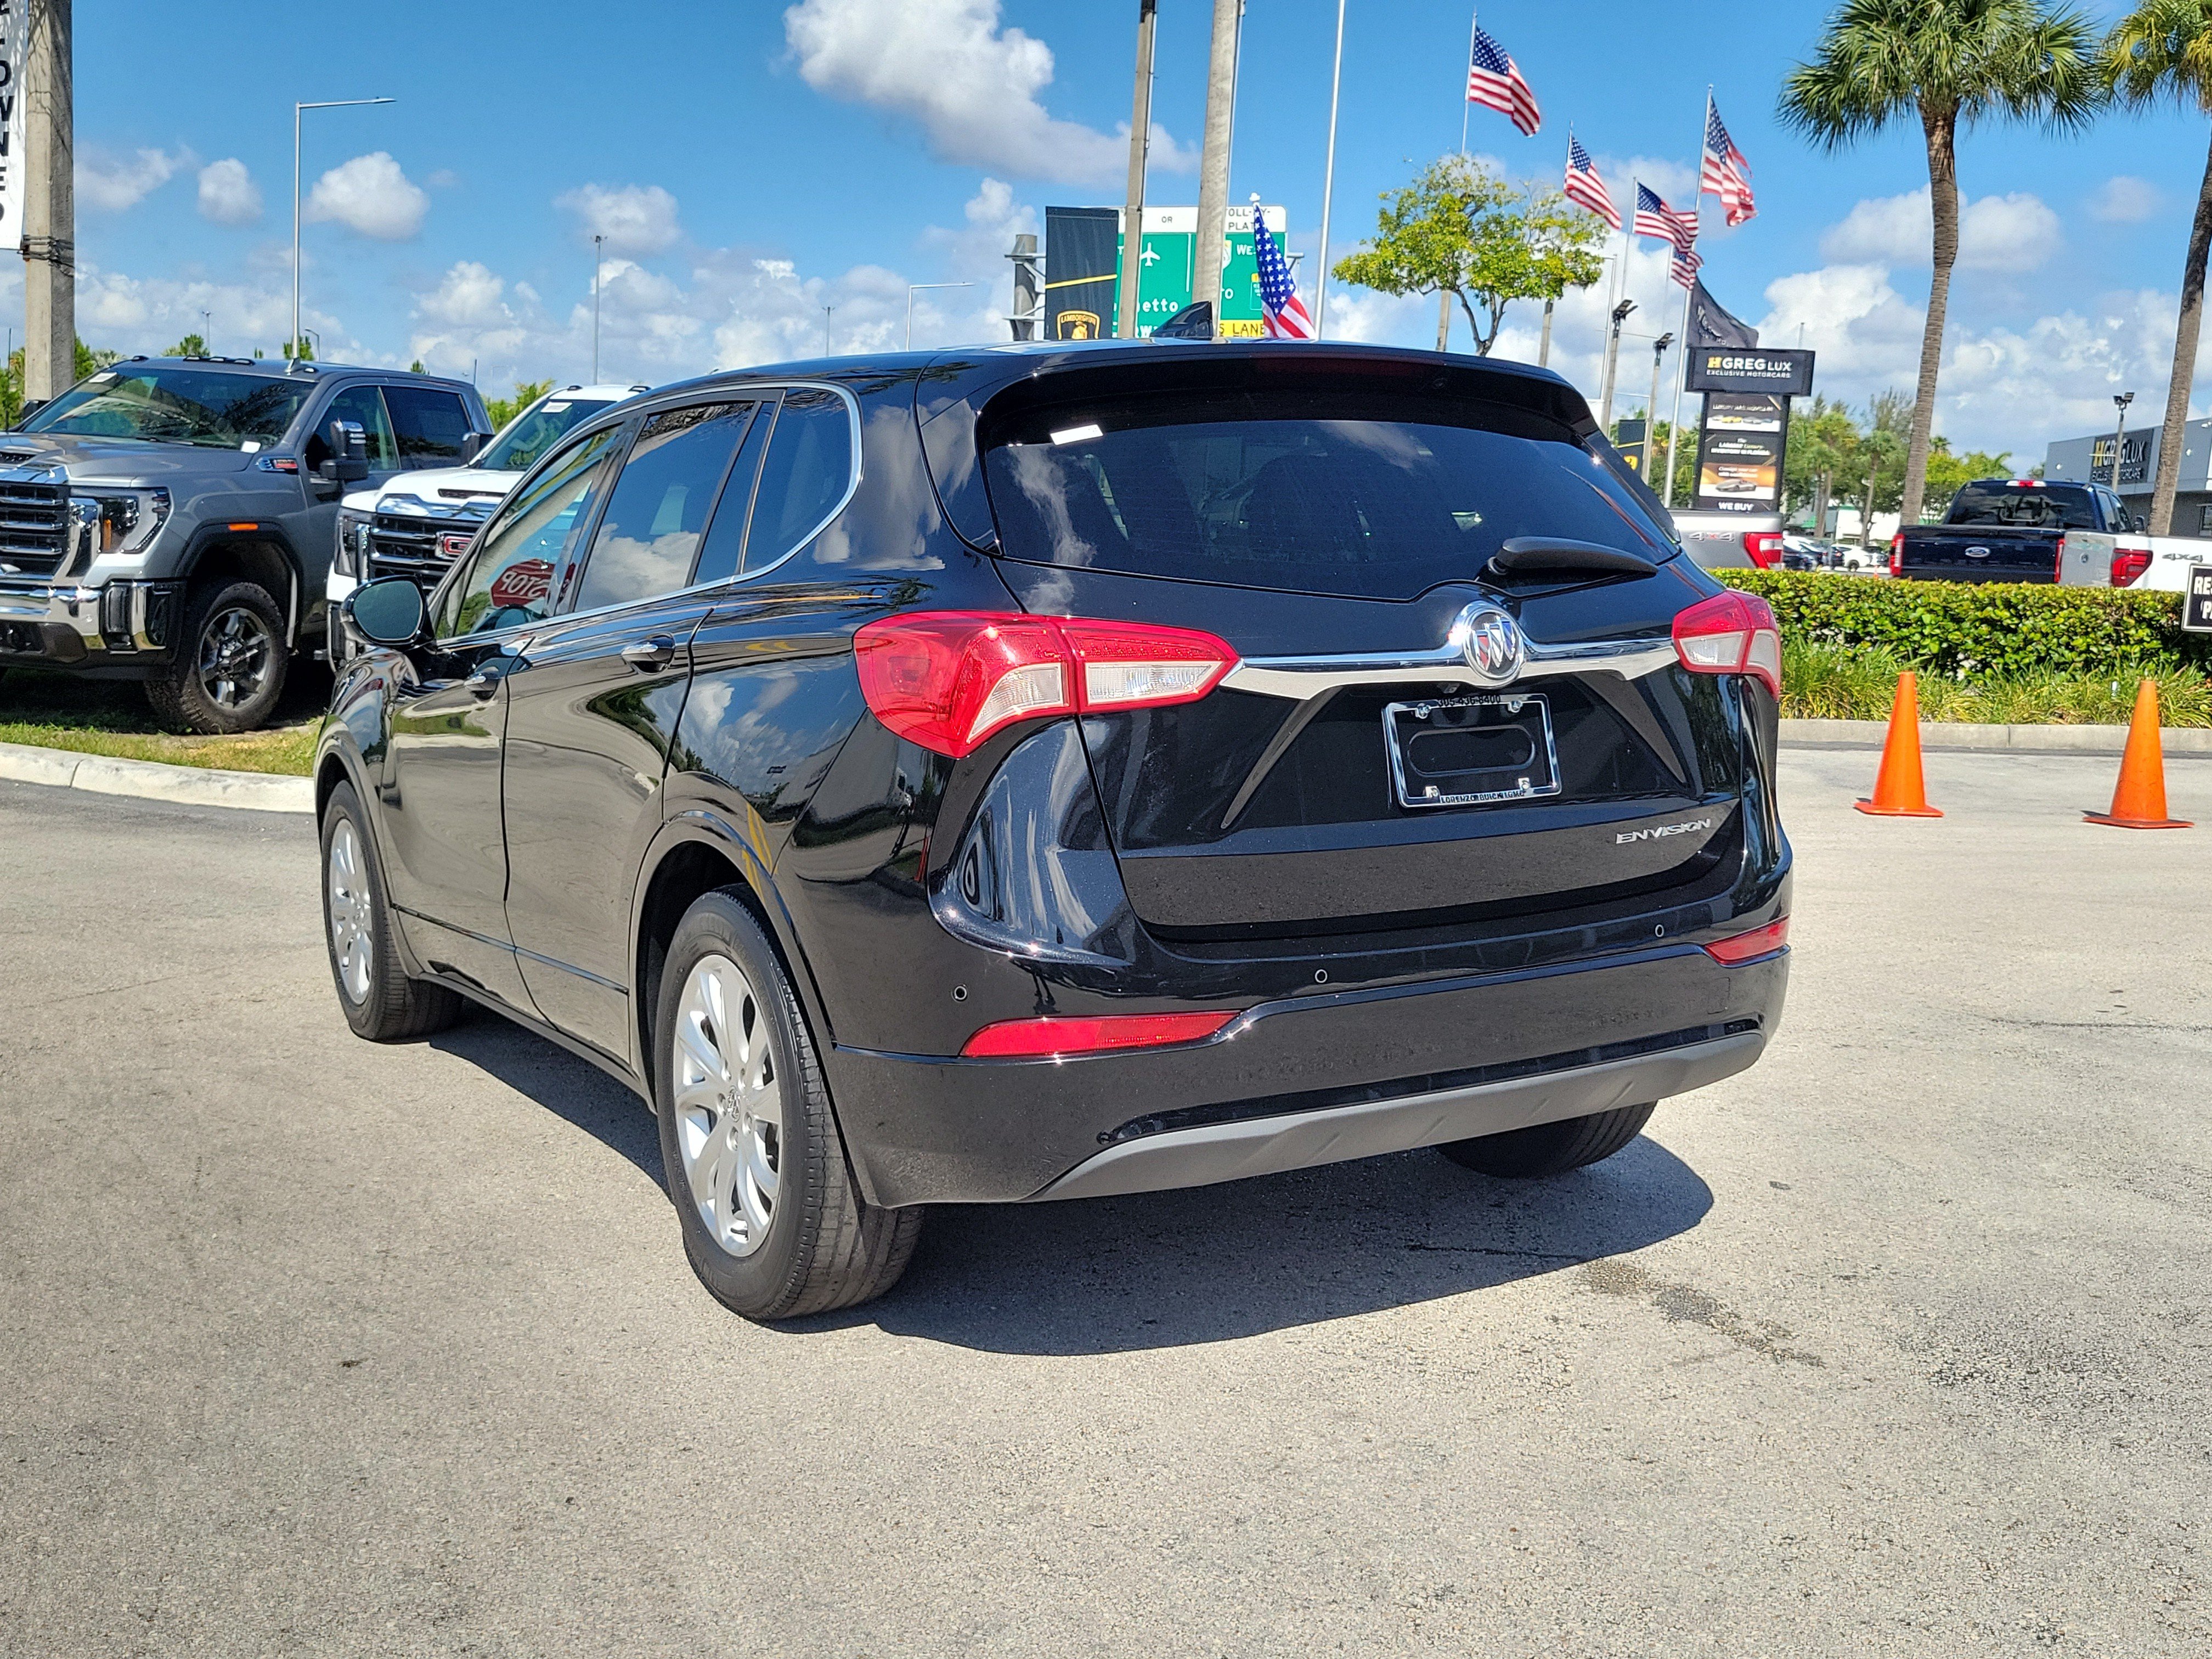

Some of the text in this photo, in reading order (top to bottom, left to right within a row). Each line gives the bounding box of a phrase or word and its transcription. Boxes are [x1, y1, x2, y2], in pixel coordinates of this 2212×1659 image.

[1137, 298, 1178, 313] etto
[1718, 501, 1754, 511] WE BUY
[2193, 576, 2212, 595] RE
[1440, 794, 1477, 804] LORENZO
[1616, 818, 1711, 844] ENVISION
